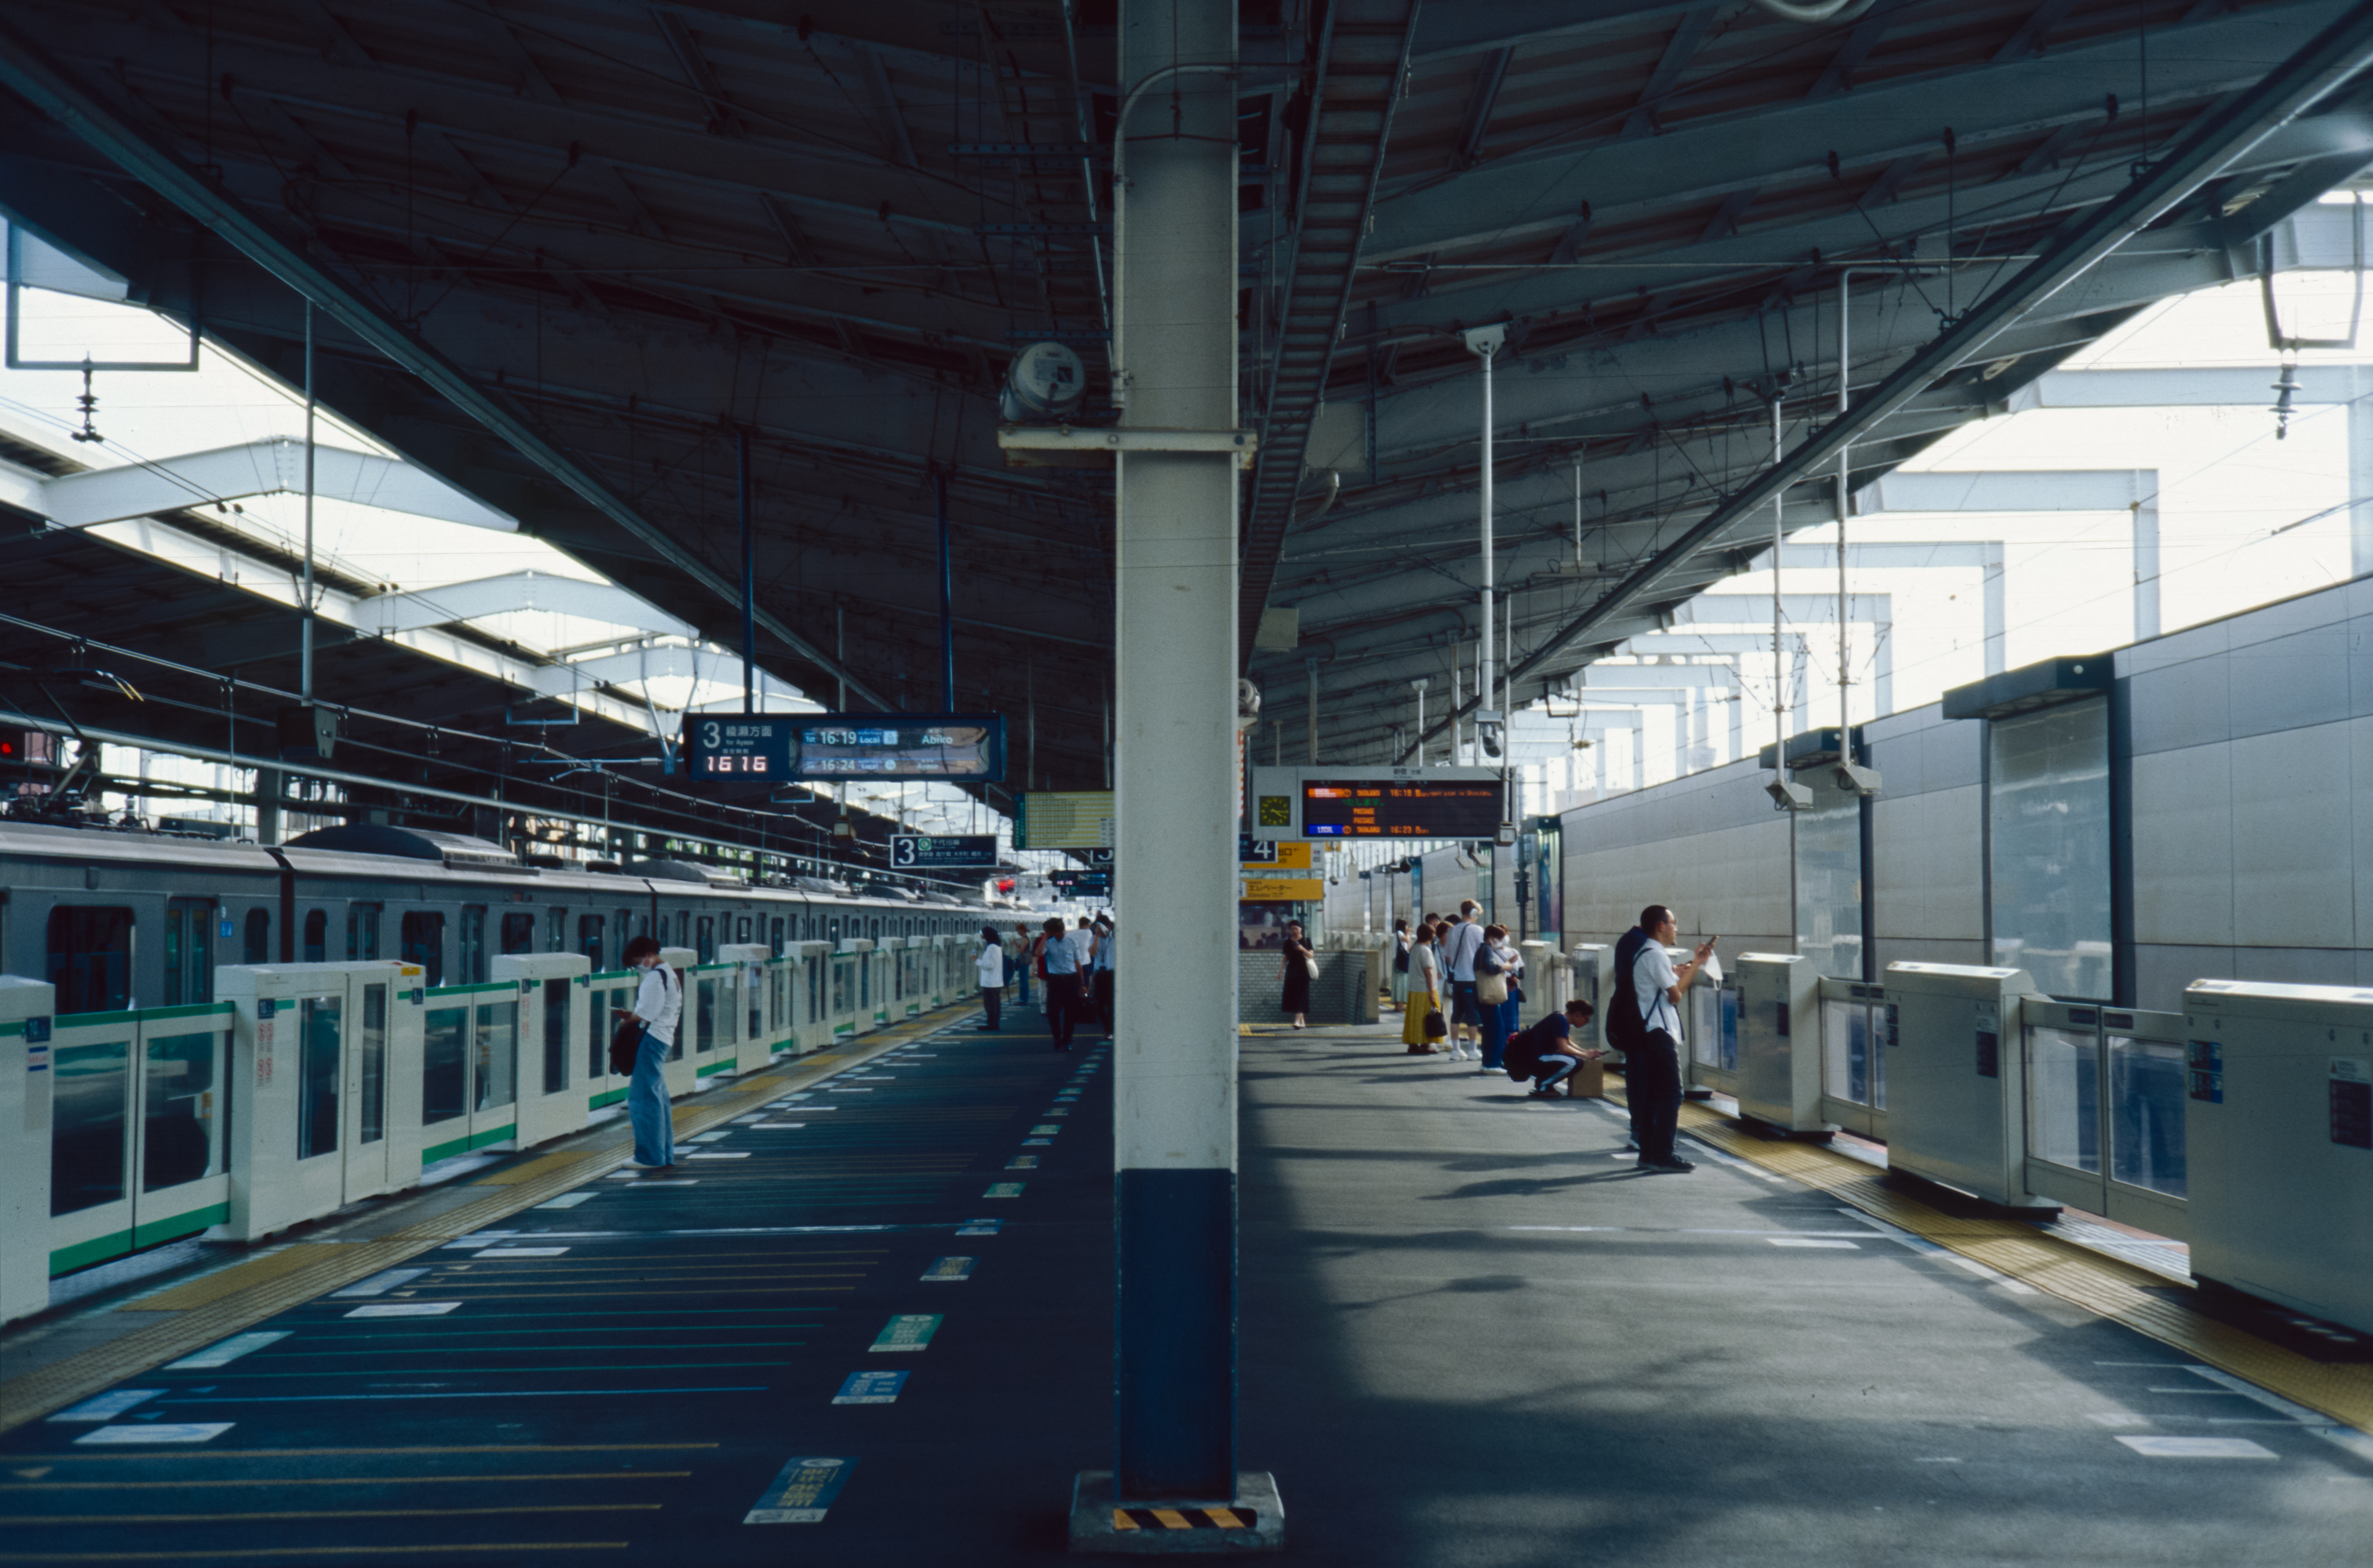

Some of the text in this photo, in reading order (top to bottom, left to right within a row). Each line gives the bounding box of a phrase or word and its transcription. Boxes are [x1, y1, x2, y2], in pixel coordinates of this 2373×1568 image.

[703, 721, 721, 749] 3
[725, 725, 772, 738] 綾瀬方面
[820, 731, 857, 745] 16:19
[860, 736, 881, 744] Local
[921, 734, 954, 744] Abiko
[735, 739, 755, 747] Ayase
[707, 756, 767, 772] 16 16
[821, 759, 856, 771] 16:24
[1390, 825, 1412, 834] 16:23
[897, 838, 915, 865] 3
[1253, 840, 1272, 860] 4
